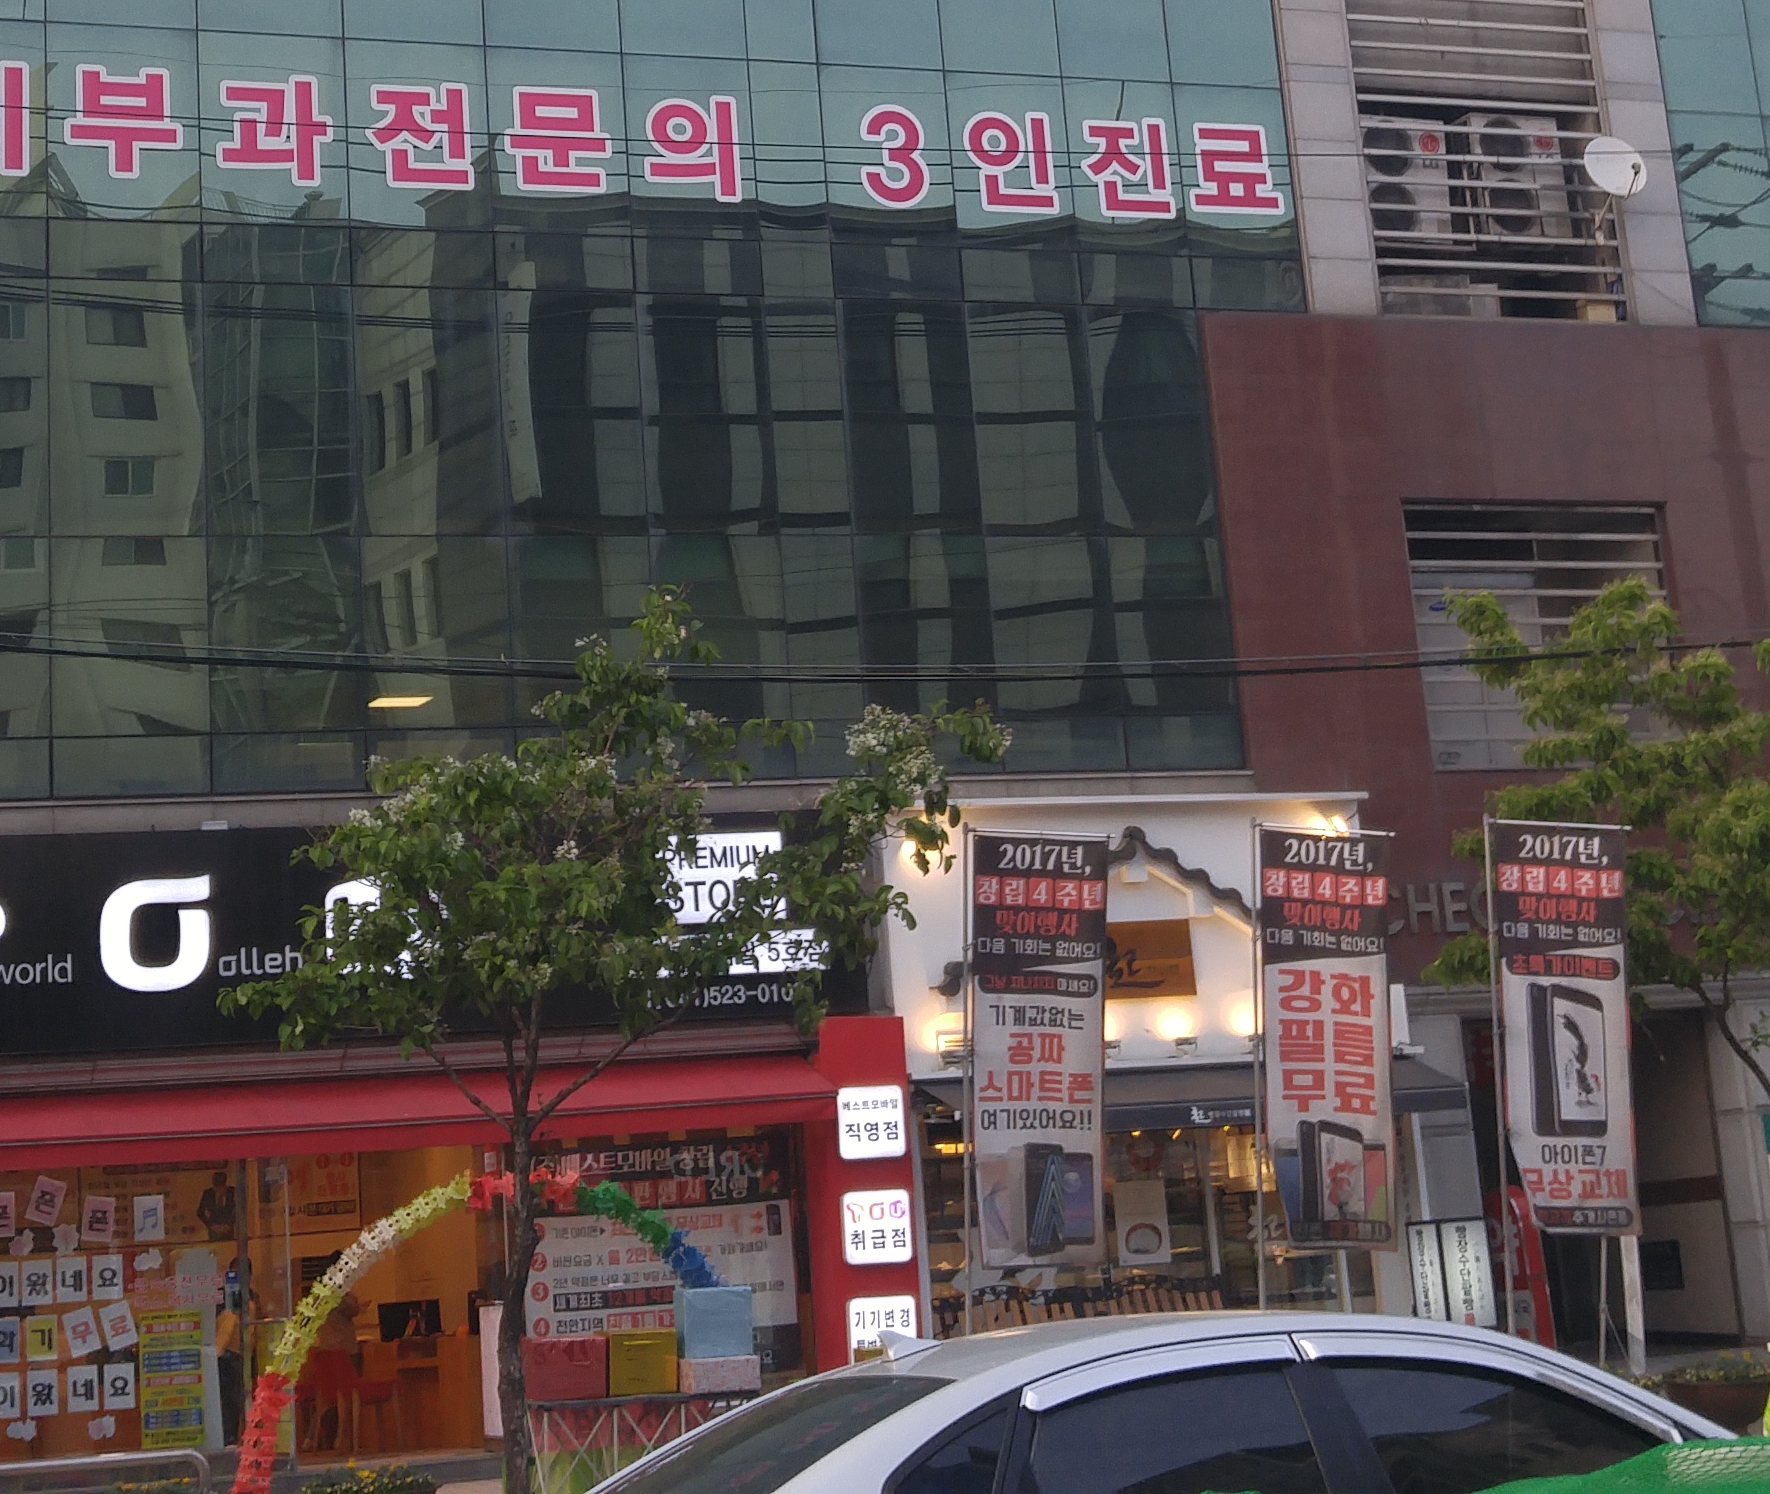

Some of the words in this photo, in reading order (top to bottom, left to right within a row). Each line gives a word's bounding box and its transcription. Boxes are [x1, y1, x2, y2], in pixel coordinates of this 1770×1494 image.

[859, 104, 1284, 219] 3인진료
[997, 843, 1092, 877] 2017년,
[1283, 838, 1375, 874] 2017년,
[1517, 834, 1610, 867] 2017년,
[977, 937, 1006, 955] 다음
[1010, 937, 1052, 957] 기회는
[1055, 940, 1102, 959] 없어요!
[1266, 927, 1295, 946] 다음
[1298, 929, 1338, 950] 기회는
[1340, 934, 1386, 954] 없어요!
[1502, 921, 1530, 939] 다음
[1533, 922, 1575, 941] 기회는
[1577, 925, 1622, 944] 없어요!
[218, 943, 305, 979] olleh
[1277, 968, 1375, 1020] 강화
[1007, 1031, 1066, 1065] 공짜
[1277, 1017, 1376, 1068] 필름
[979, 1070, 1096, 1105] 스마트폰
[1281, 1068, 1378, 1117] 무료
[844, 1120, 900, 1143] 직영점
[1540, 1143, 1608, 1167] 아이폰7
[850, 1227, 907, 1252] 취급점
[854, 1307, 912, 1330] 기기변경
